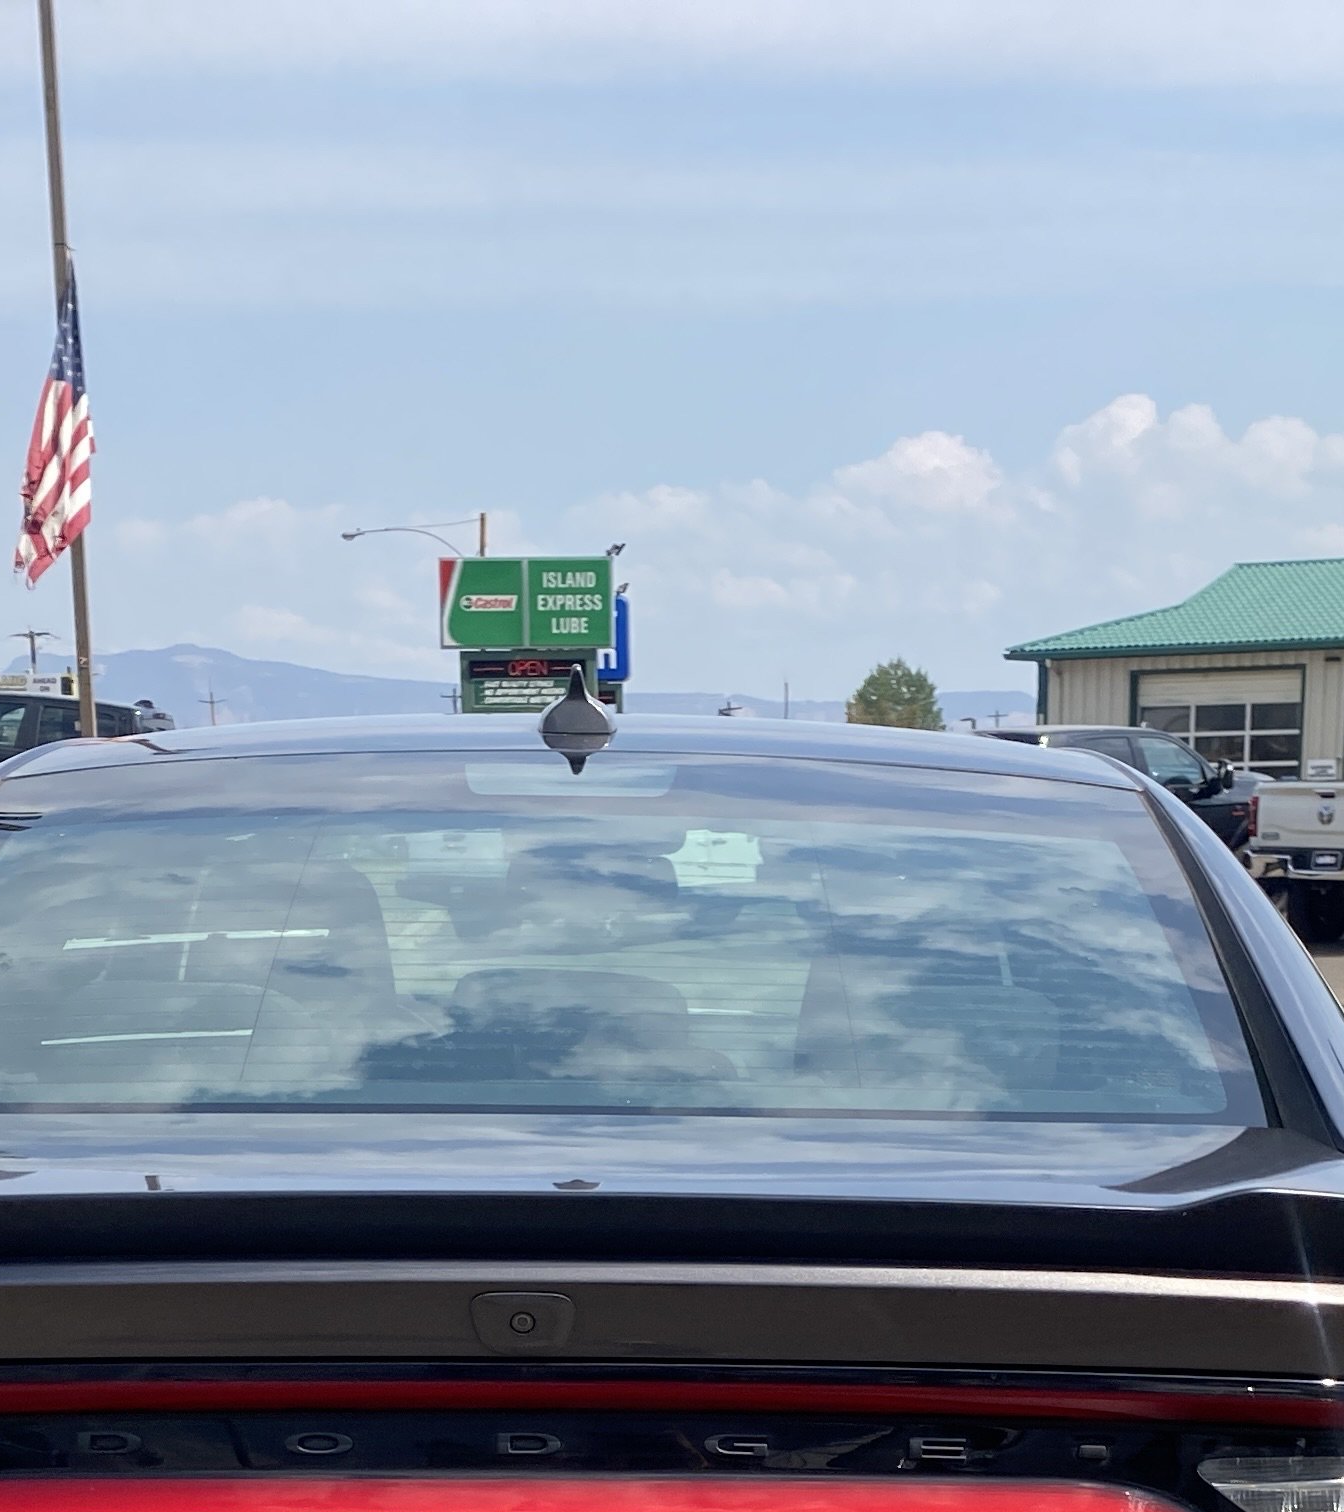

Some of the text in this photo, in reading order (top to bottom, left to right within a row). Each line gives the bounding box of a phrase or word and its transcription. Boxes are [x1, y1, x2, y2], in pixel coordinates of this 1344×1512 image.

[542, 571, 597, 588] ISLAND
[536, 594, 603, 611] EXPRESS
[551, 617, 590, 634] LUBE
[508, 660, 548, 676] OPEN
